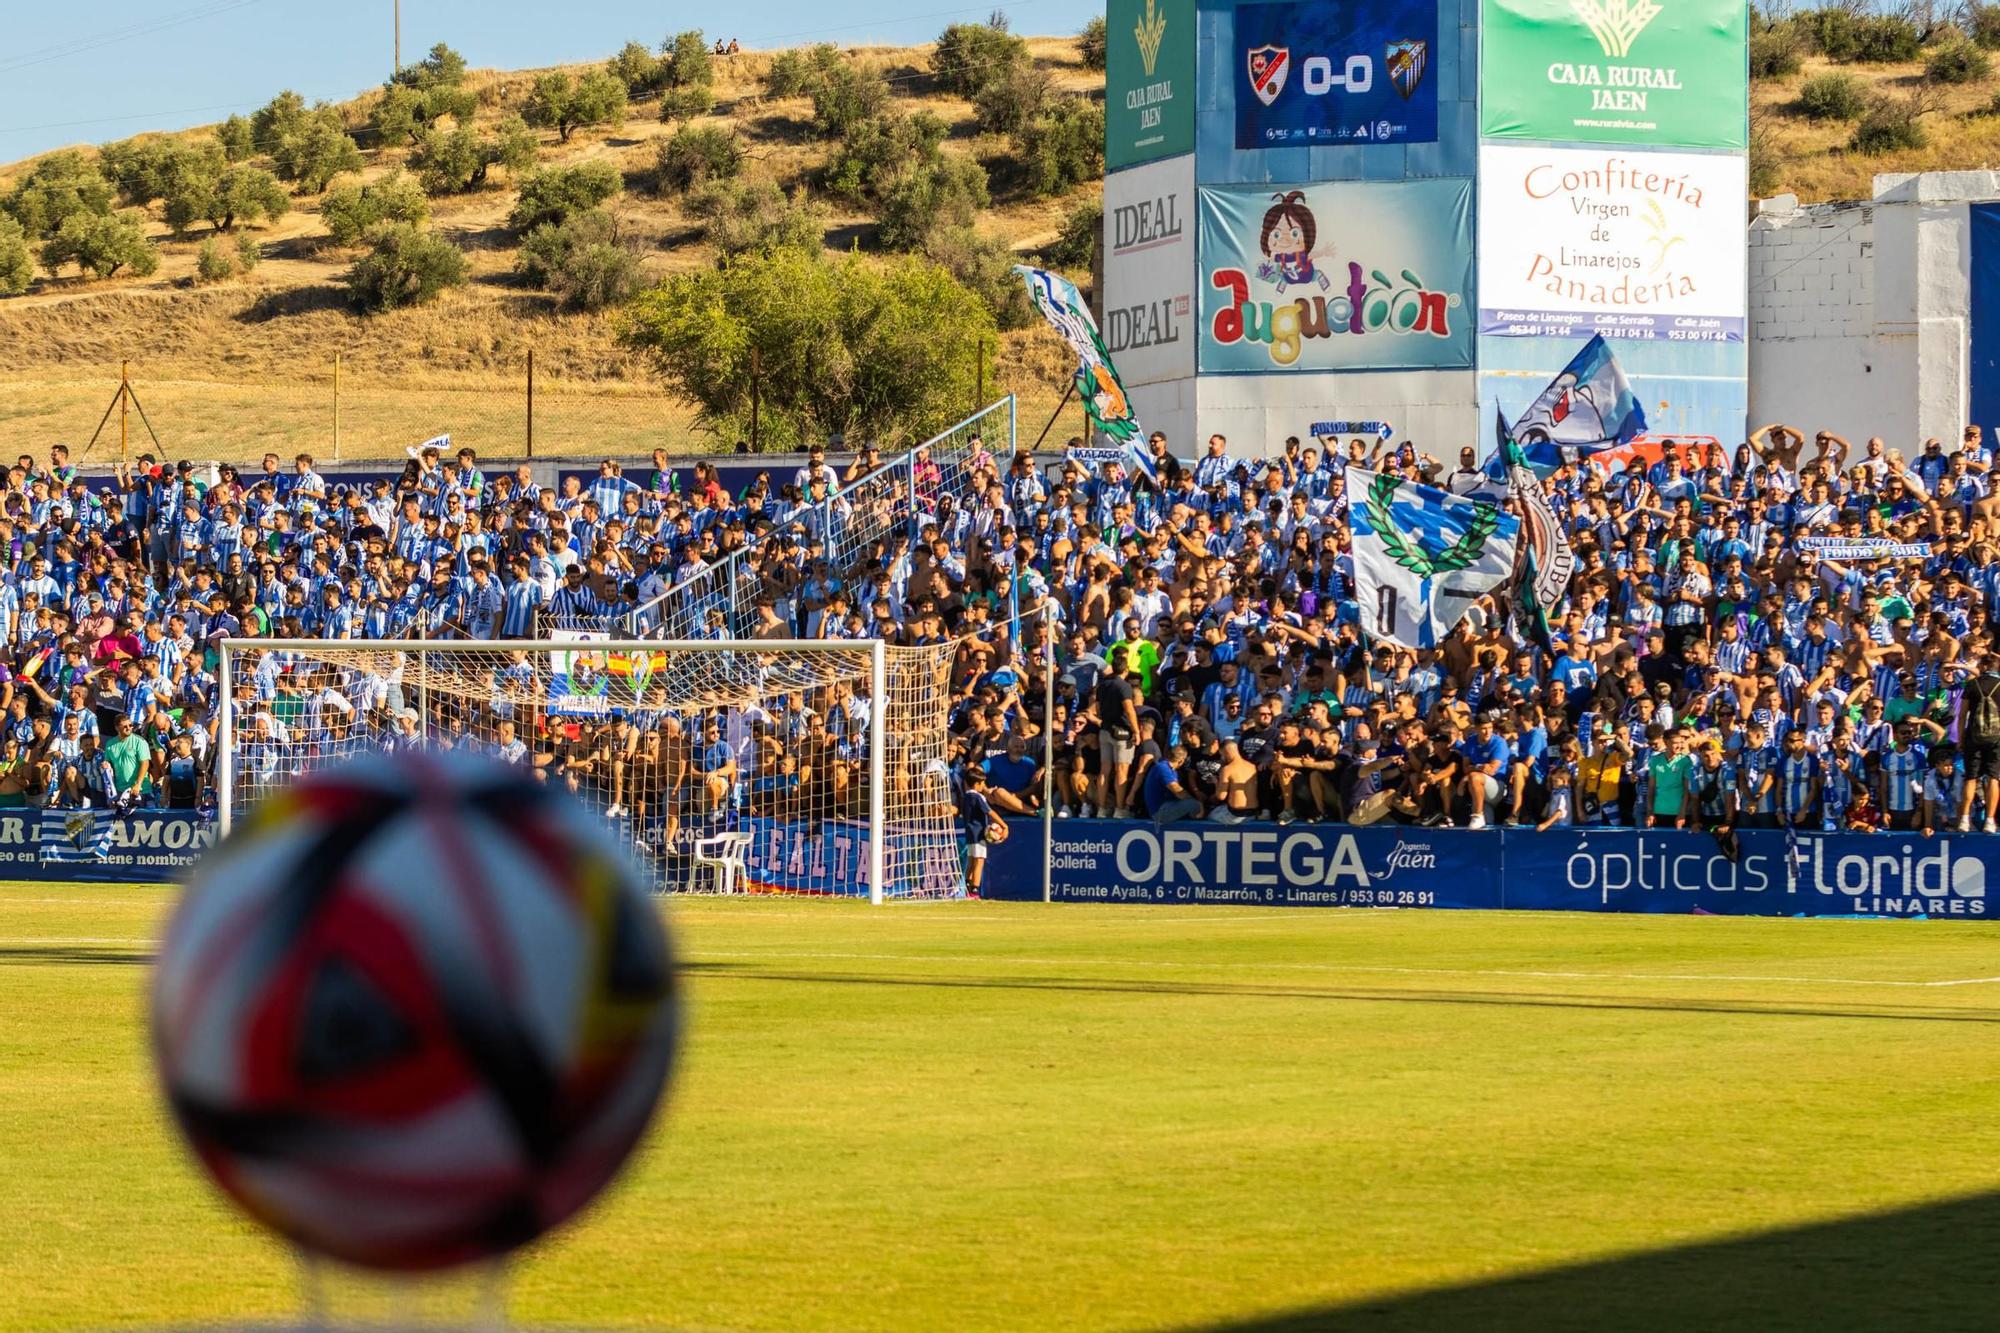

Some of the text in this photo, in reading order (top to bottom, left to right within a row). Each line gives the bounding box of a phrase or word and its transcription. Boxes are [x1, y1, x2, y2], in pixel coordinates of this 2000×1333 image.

[1548, 63, 1682, 89] CAJA RURAL
[1126, 80, 1173, 110] CAJA RURAL
[1592, 90, 1648, 111] JAEN
[1140, 106, 1161, 130] JAEN
[1573, 119, 1656, 129] www.ruralvia.com
[1525, 159, 1703, 208] Confitería
[1571, 197, 1630, 220] Virgen
[1114, 194, 1182, 249] IDEAL
[1590, 224, 1610, 241] de
[1561, 246, 1641, 271] Linarejos
[1526, 253, 1697, 305] Panadería
[1108, 299, 1179, 353] IDEAL
[1497, 311, 1583, 325] Paseo de Linarejos
[1595, 315, 1654, 326] Calle Serrallo
[1675, 318, 1720, 328] Calle Jaén
[1509, 325, 1527, 334] 953
[1546, 326, 1556, 335] 15
[1557, 327, 1571, 336] 44
[1594, 328, 1655, 338] 953 81 04 16
[1668, 330, 1727, 340] 953 00 91 44
[1313, 422, 1379, 434] ONDO SU
[1824, 545, 1922, 558] FONDO SUR
[108, 819, 219, 849] AMON
[1050, 839, 1113, 853] Panadería
[20, 851, 34, 863] en
[1050, 855, 1097, 869] Bollería
[1116, 829, 1371, 887] ORTEGA
[1378, 850, 1436, 880] Jaén
[1567, 838, 1767, 903] ópticas
[1049, 884, 1434, 904] C/ Fuente Ayala, 6 C/ Mazarrón, 8 Linares 953 60 26 91
[1854, 897, 1986, 914] LINARES
